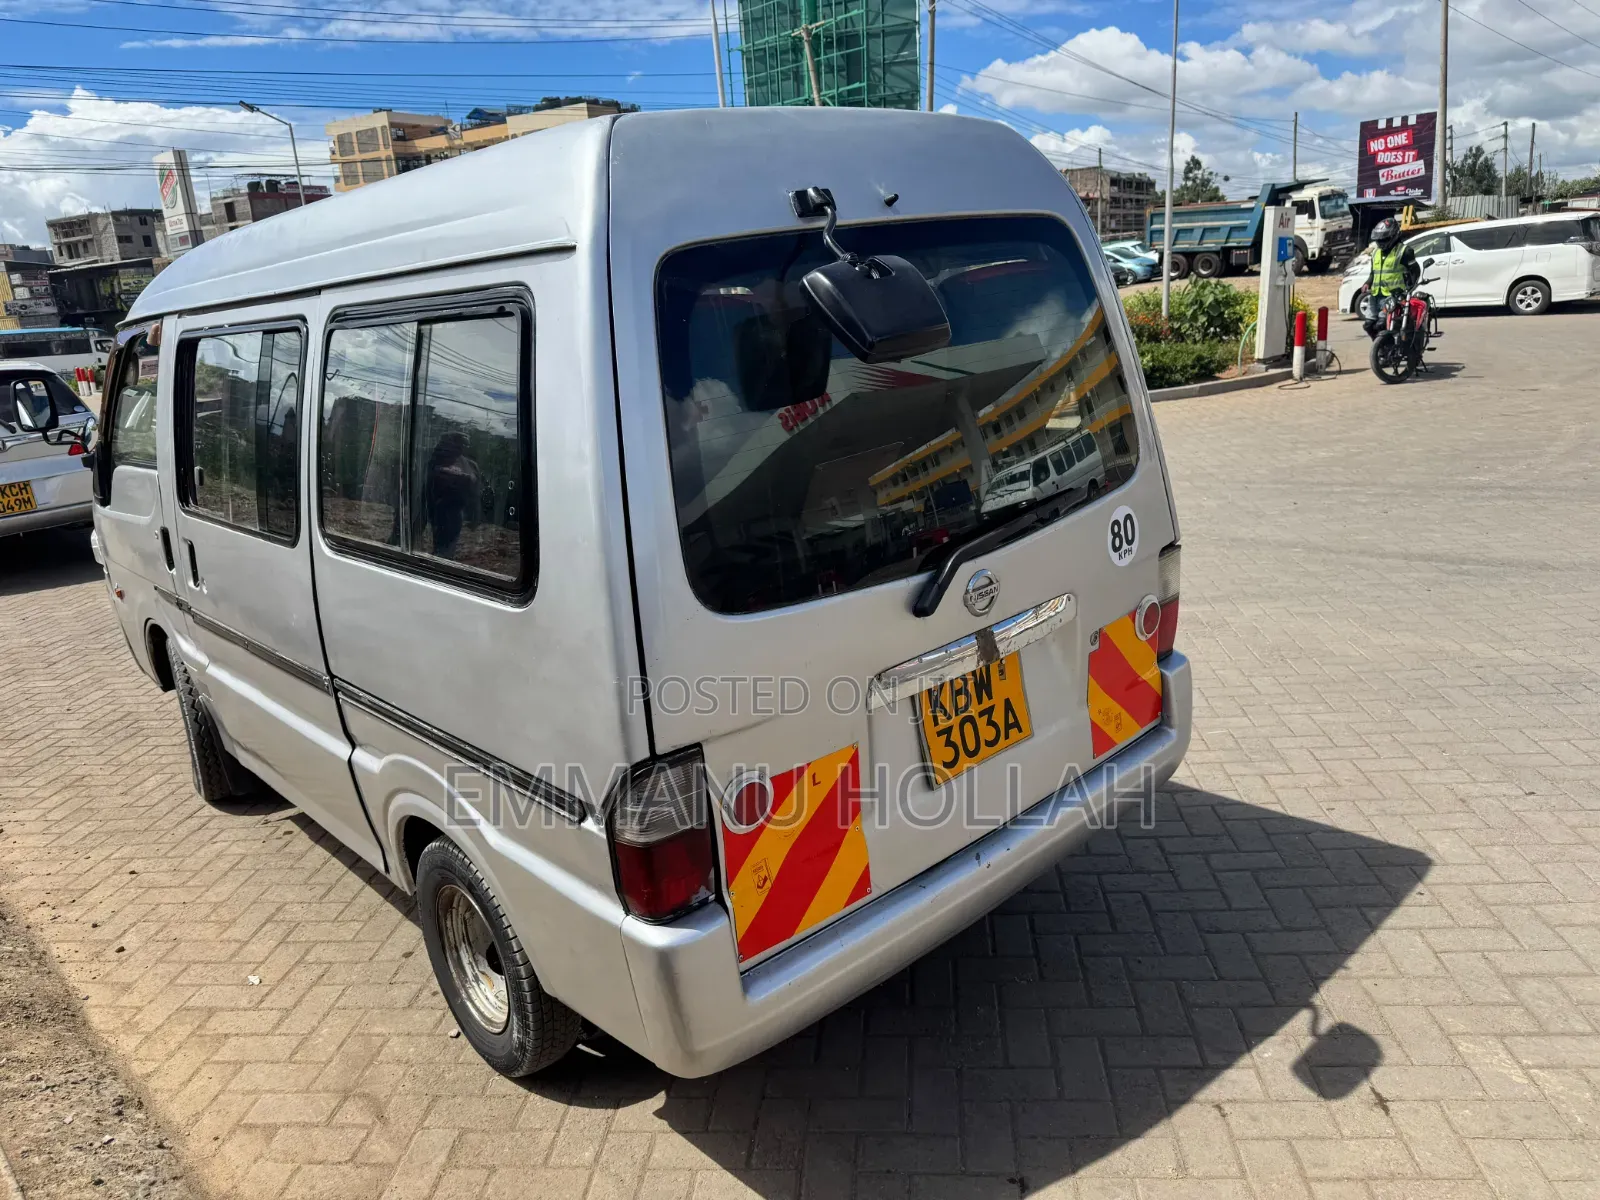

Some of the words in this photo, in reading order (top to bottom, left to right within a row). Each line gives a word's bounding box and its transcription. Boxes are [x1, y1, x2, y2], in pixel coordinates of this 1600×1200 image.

[1370, 138, 1385, 152] NO
[1387, 132, 1408, 148] ONE
[1377, 151, 1403, 163] DOES
[1405, 151, 1415, 163] IT
[1381, 167, 1423, 181] Butter
[1278, 212, 1291, 229] Air
[0, 482, 29, 498] KCH
[1110, 513, 1136, 553] 80
[1118, 546, 1133, 561] KPH
[969, 585, 998, 603] NISSAN
[927, 663, 993, 727] KBW
[936, 697, 1023, 769] 303A
[812, 772, 821, 787] L
